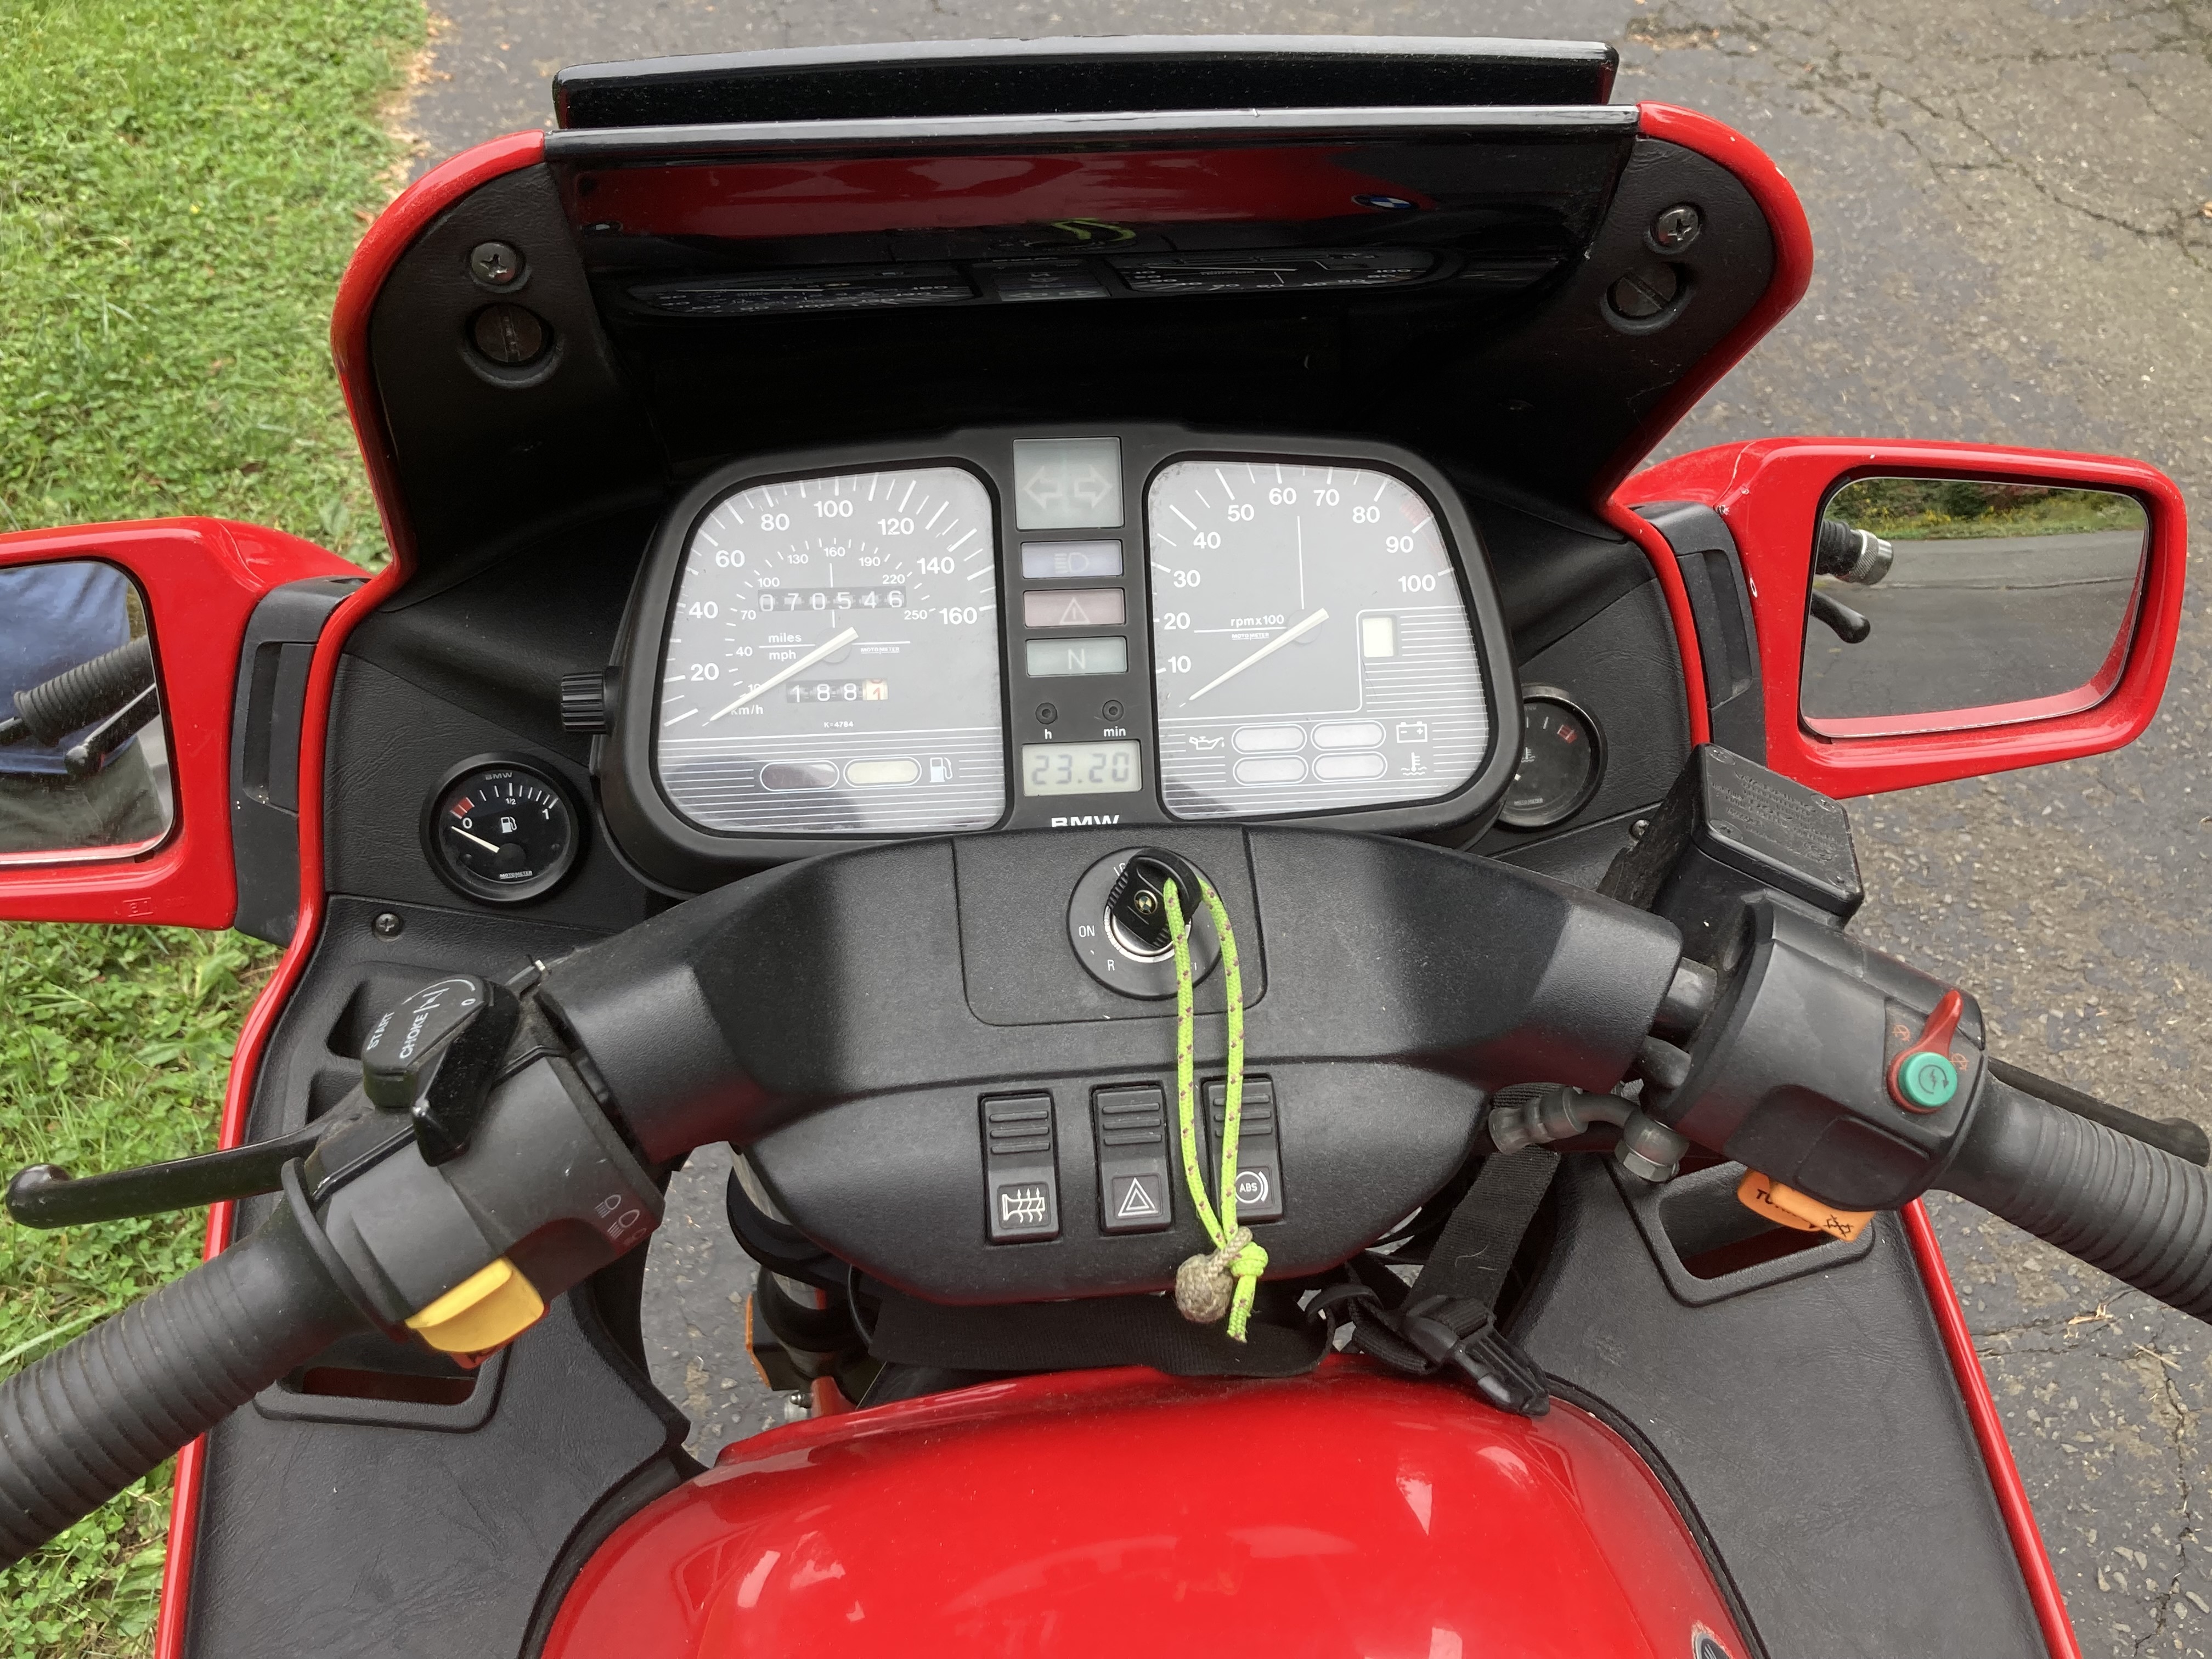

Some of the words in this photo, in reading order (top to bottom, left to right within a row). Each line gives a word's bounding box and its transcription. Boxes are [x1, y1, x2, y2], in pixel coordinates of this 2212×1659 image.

[1269, 487, 1297, 505] 60
[1313, 489, 1340, 506] 70
[814, 500, 853, 518] 100
[1227, 504, 1255, 522] 50
[1352, 506, 1380, 523] 80
[761, 513, 790, 531] 80
[877, 517, 915, 535] 120
[1193, 531, 1221, 549] 40
[1385, 535, 1414, 554] 90
[715, 550, 745, 568] 60
[787, 554, 809, 564] 130
[823, 546, 846, 557] 160
[859, 556, 881, 567] 190
[917, 556, 955, 574] 140
[758, 577, 780, 588] 100
[882, 574, 906, 584] 220
[1173, 569, 1201, 588] 30
[1398, 574, 1436, 592] 100
[760, 590, 902, 612] 070546
[689, 601, 719, 619] 40
[741, 610, 757, 620] 70
[904, 610, 928, 620] 250
[939, 607, 978, 625] 160
[1164, 612, 1190, 630] 20
[768, 632, 802, 643] miles
[736, 646, 753, 657] 40
[769, 650, 796, 662] mph
[1068, 648, 1086, 670] N
[691, 663, 719, 681] 20
[1167, 655, 1192, 673] 10
[1045, 729, 1052, 740] h
[1103, 726, 1126, 737] min
[485, 772, 512, 780] BMW
[542, 808, 550, 820] 1
[1051, 814, 1120, 827] BMW
[462, 817, 472, 829] 0
[1079, 925, 1095, 938] ON
[1107, 959, 1115, 971] R
[366, 1012, 395, 1052] START
[399, 1012, 429, 1059] CHOKE
[1239, 1182, 1258, 1193] ABS
